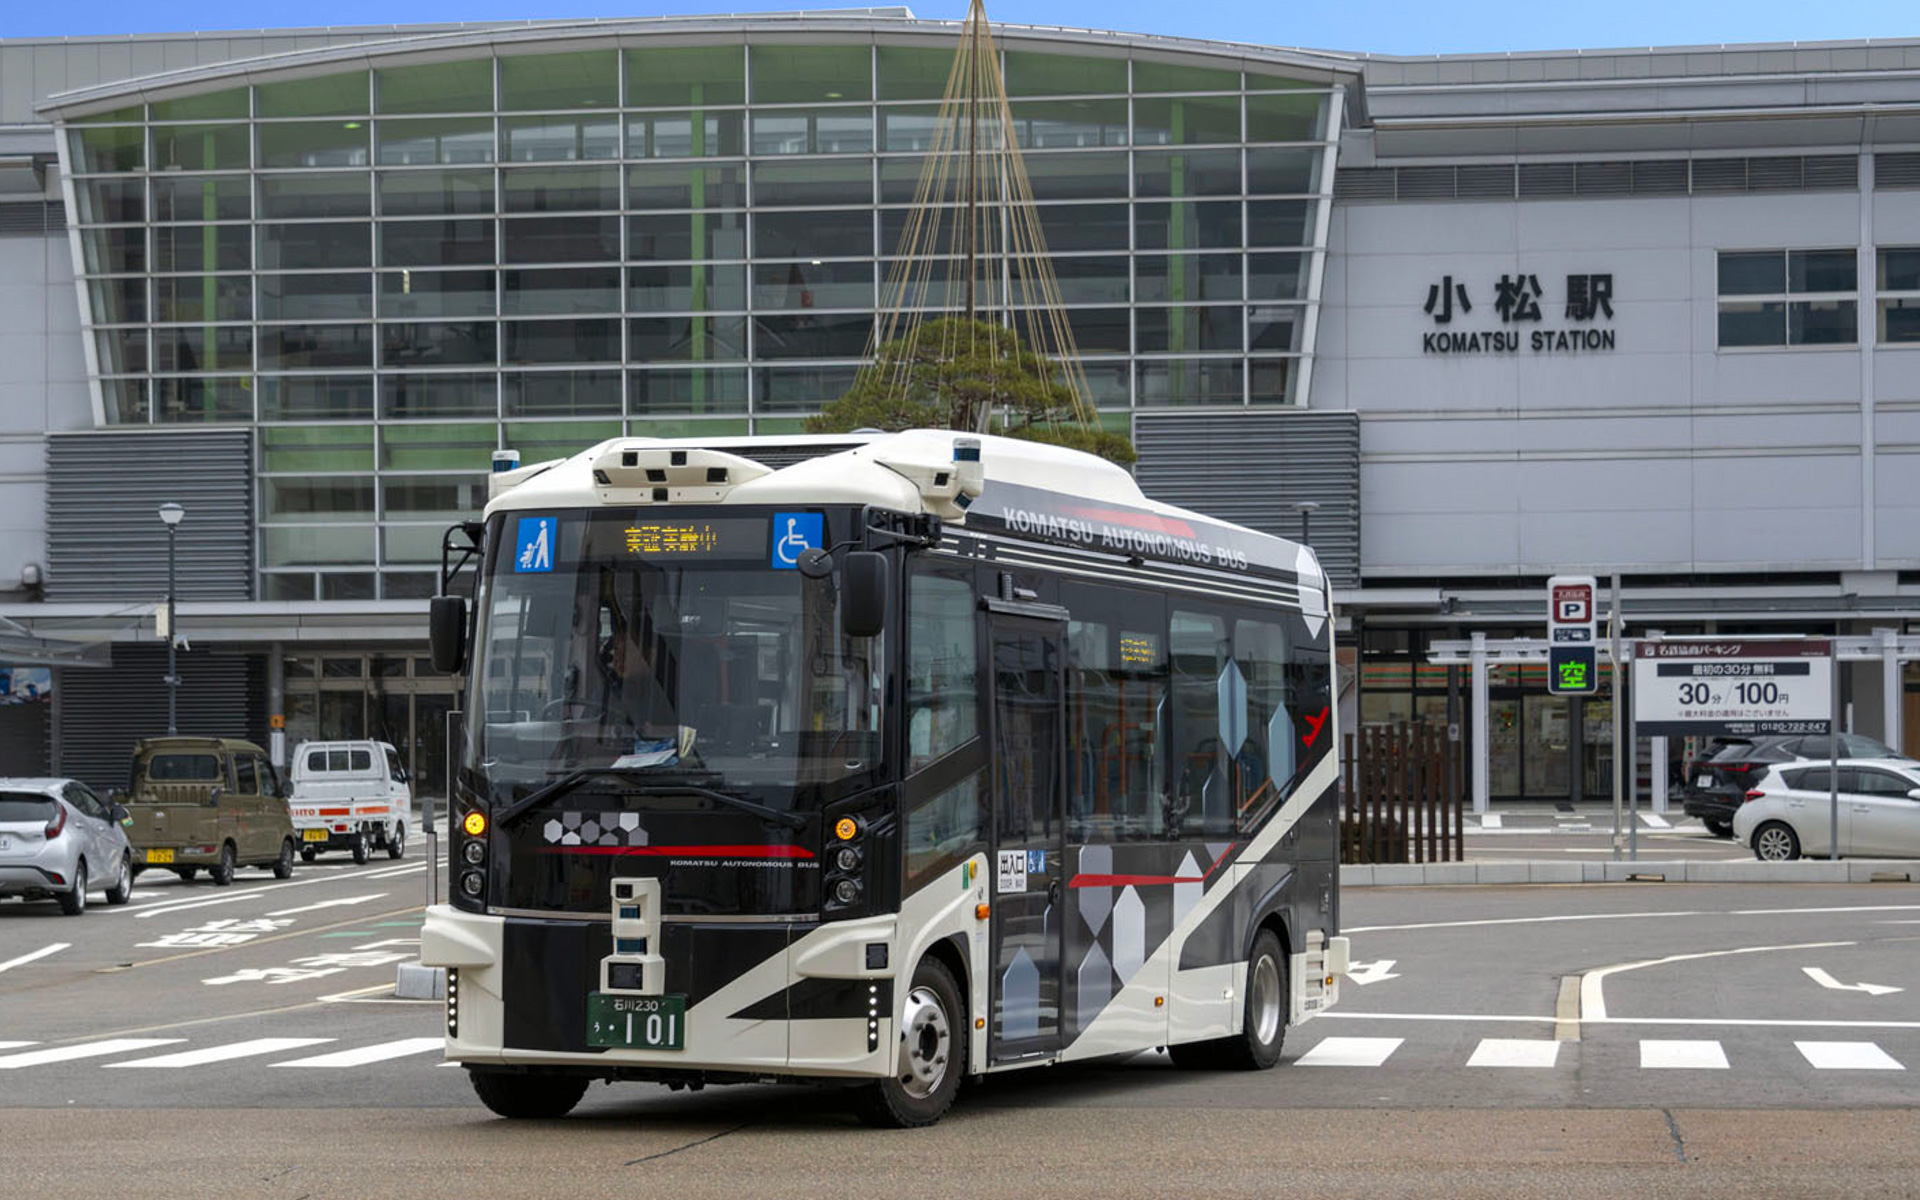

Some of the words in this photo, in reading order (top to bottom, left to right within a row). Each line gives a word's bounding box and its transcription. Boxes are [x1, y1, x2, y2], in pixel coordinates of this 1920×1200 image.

[1423, 273, 1614, 323] 小松駅
[1423, 331, 1519, 353] KOMATSU
[1531, 329, 1615, 350] STATION
[1003, 507, 1093, 544] KOMATSU
[1102, 526, 1211, 563] AUTONOMOUS
[1217, 546, 1248, 570] BUS
[1564, 603, 1581, 617] P
[1559, 660, 1587, 688] 空
[722, 860, 794, 868] AUTONOMOUS
[797, 861, 820, 869] BUS
[1000, 853, 1025, 876] 出入口
[614, 999, 659, 1012] 石川230
